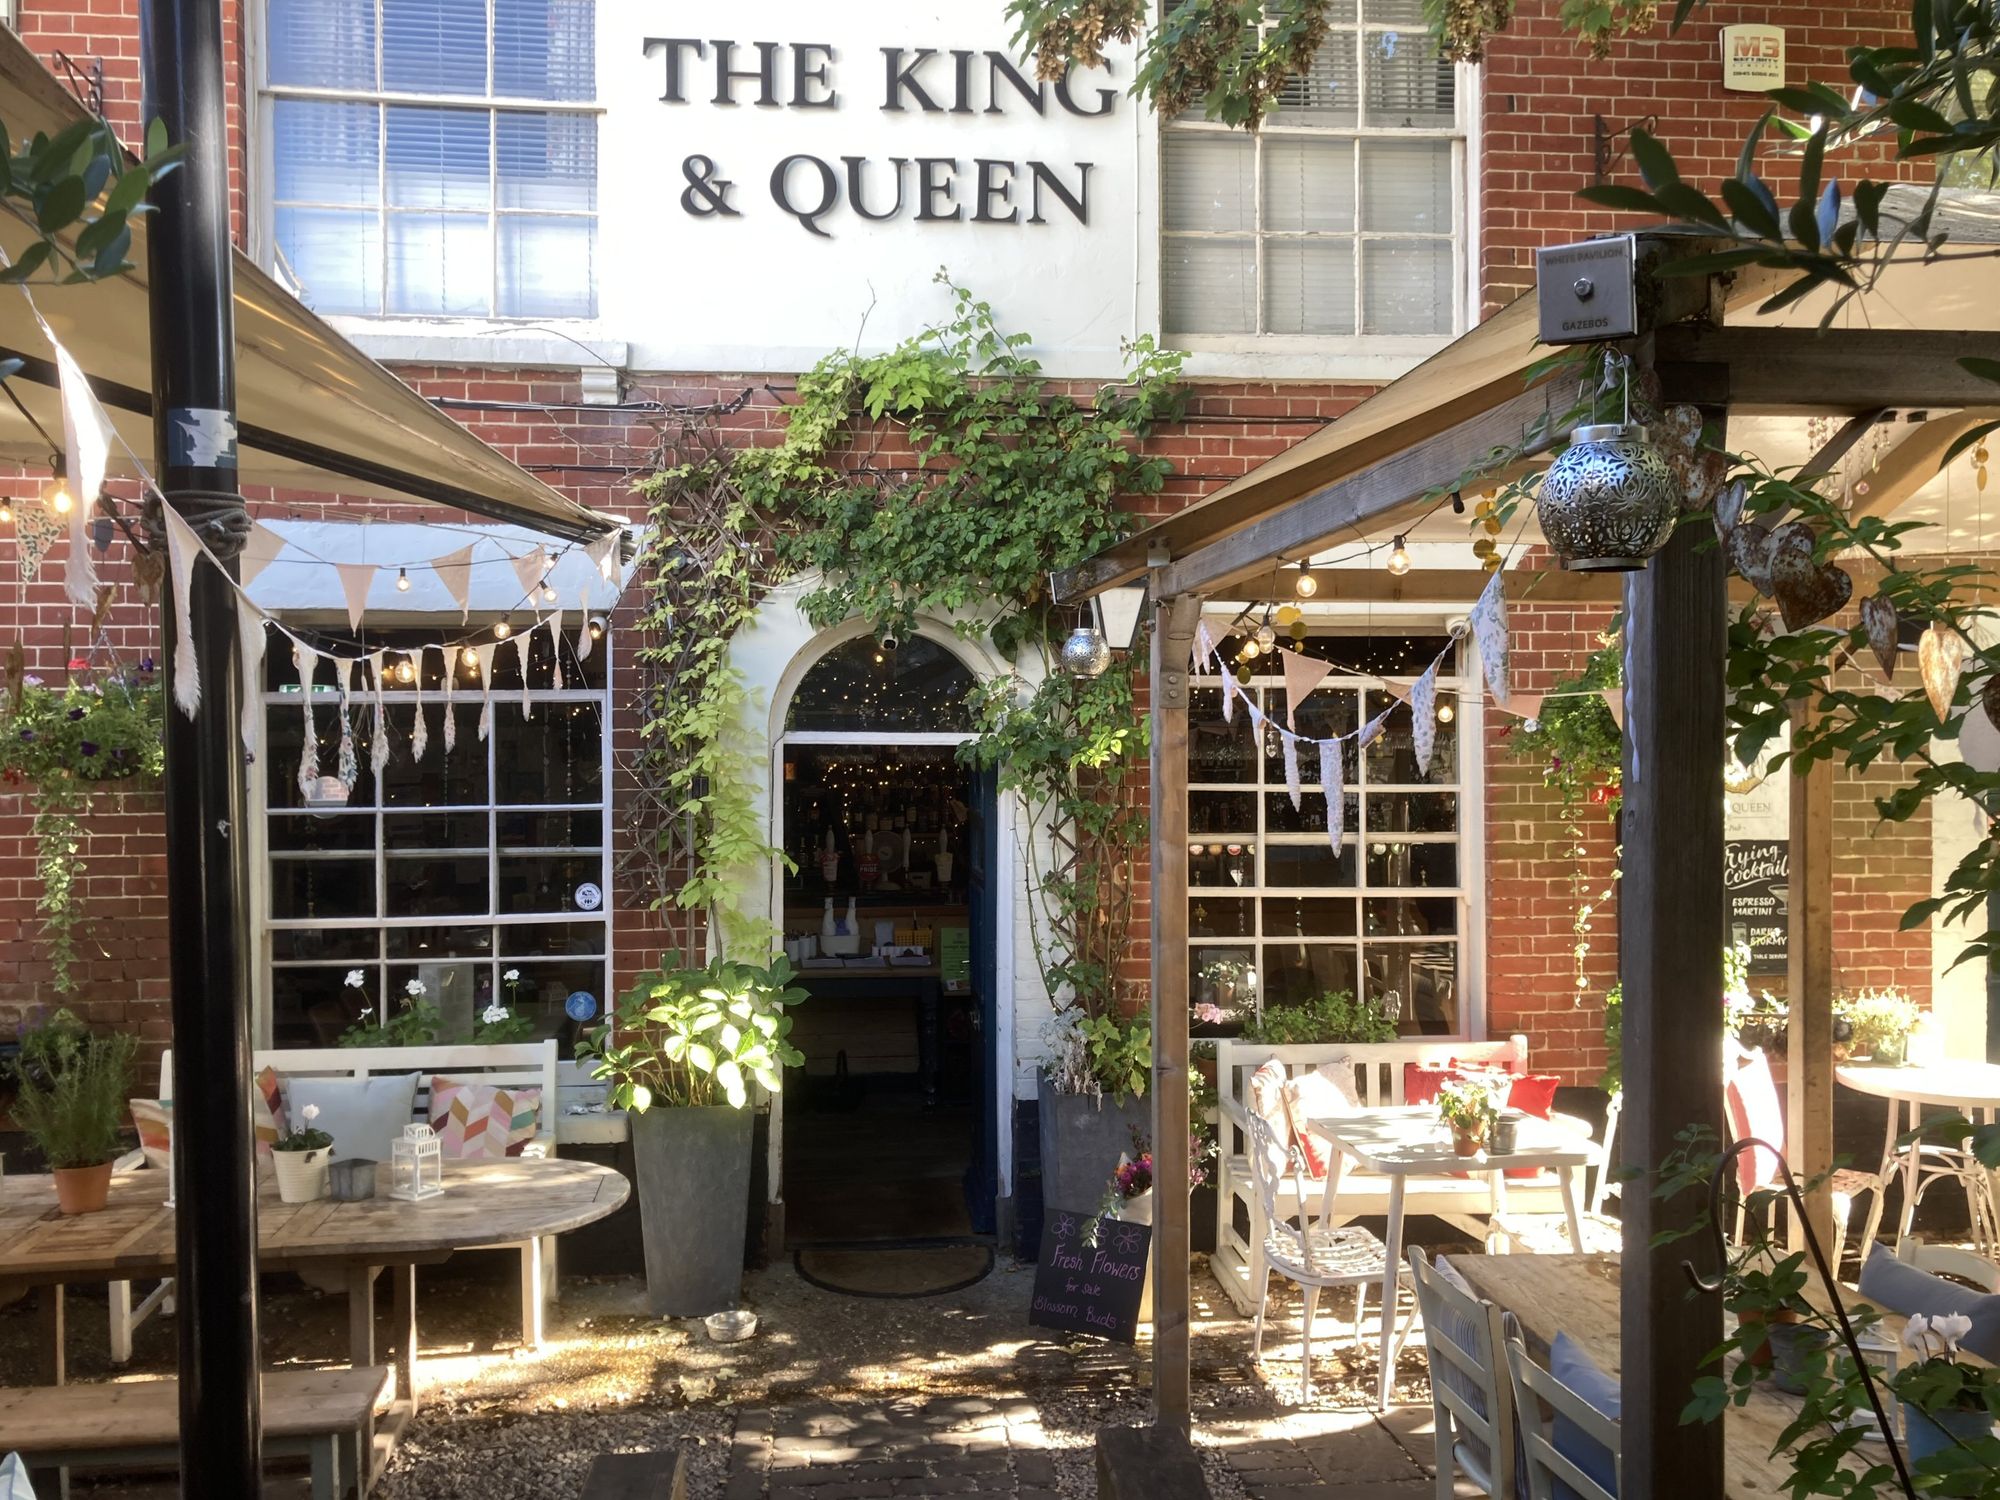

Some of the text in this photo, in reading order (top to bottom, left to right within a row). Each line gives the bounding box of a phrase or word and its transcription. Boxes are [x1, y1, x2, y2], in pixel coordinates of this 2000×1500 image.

[1733, 36, 1780, 57] M3
[642, 37, 1119, 118] THE KING
[680, 154, 1094, 238] & QUEEN
[1545, 247, 1623, 266] WHITE PAVILION
[1562, 318, 1608, 331] GAZEBOS
[1731, 802, 1771, 814] QUEEN
[1724, 842, 1782, 870] rying
[1724, 855, 1789, 886] Cocktail
[1732, 897, 1776, 907] ESPRESSO
[1733, 907, 1772, 916] MARTINI
[1750, 936, 1788, 946] STORMY
[1050, 1242, 1142, 1281] Fresh Flowers
[1065, 1277, 1079, 1297] for
[1085, 1305, 1117, 1330] Buds
